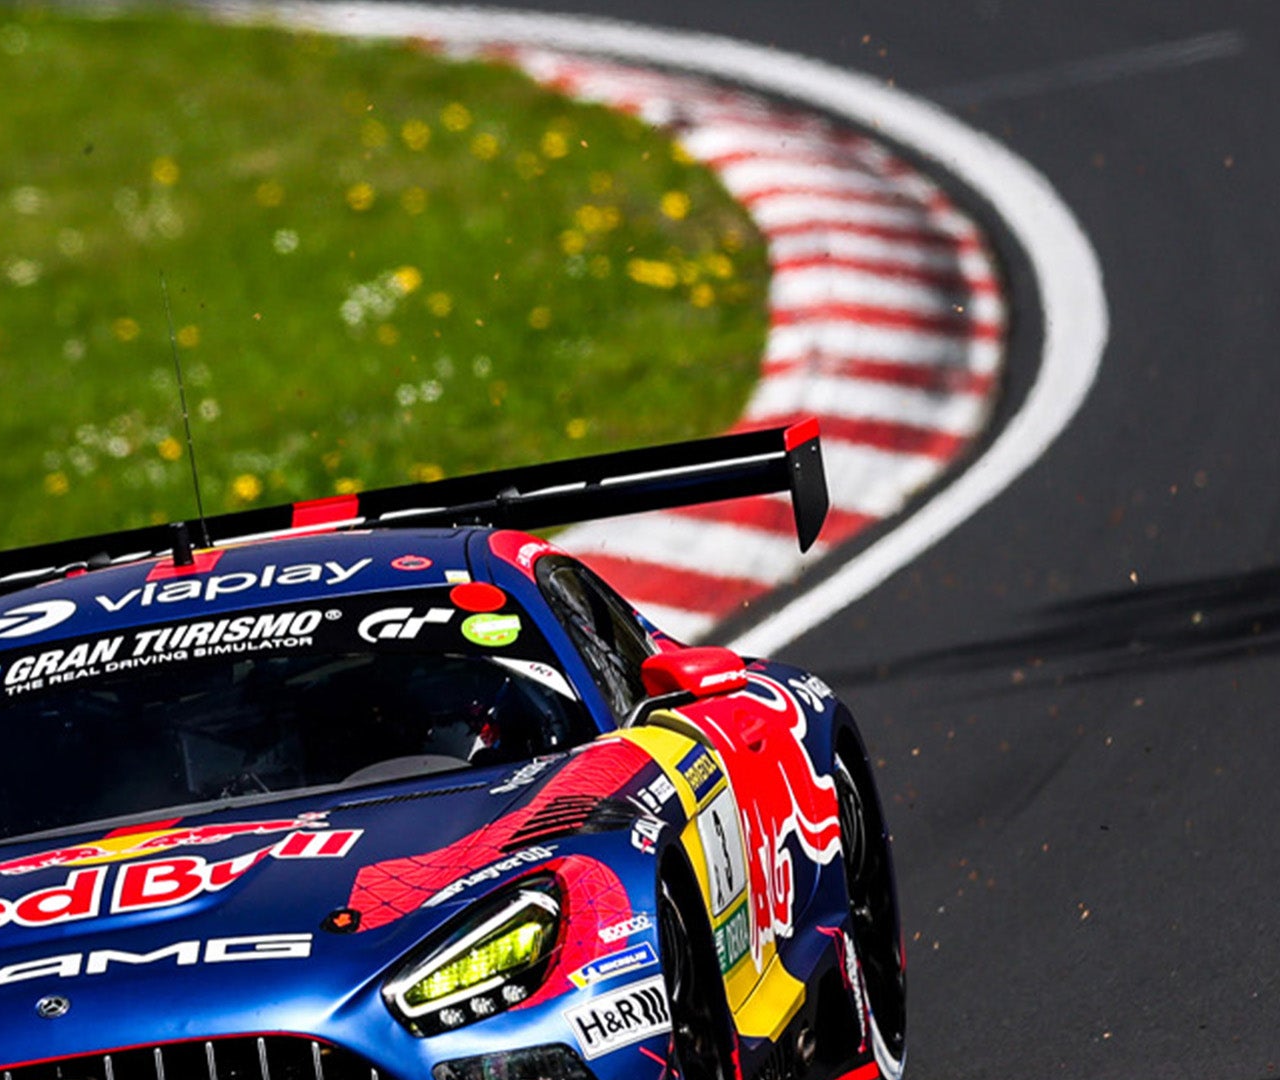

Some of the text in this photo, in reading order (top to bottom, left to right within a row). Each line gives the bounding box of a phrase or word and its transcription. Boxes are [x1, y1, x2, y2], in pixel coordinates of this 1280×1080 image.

[94, 558, 374, 612] viaplay
[4, 635, 125, 686] GRAN
[5, 636, 314, 696] THE REAL DRIVING SIMULATOR
[110, 829, 364, 914] Bull
[576, 1000, 642, 1044] H&R
